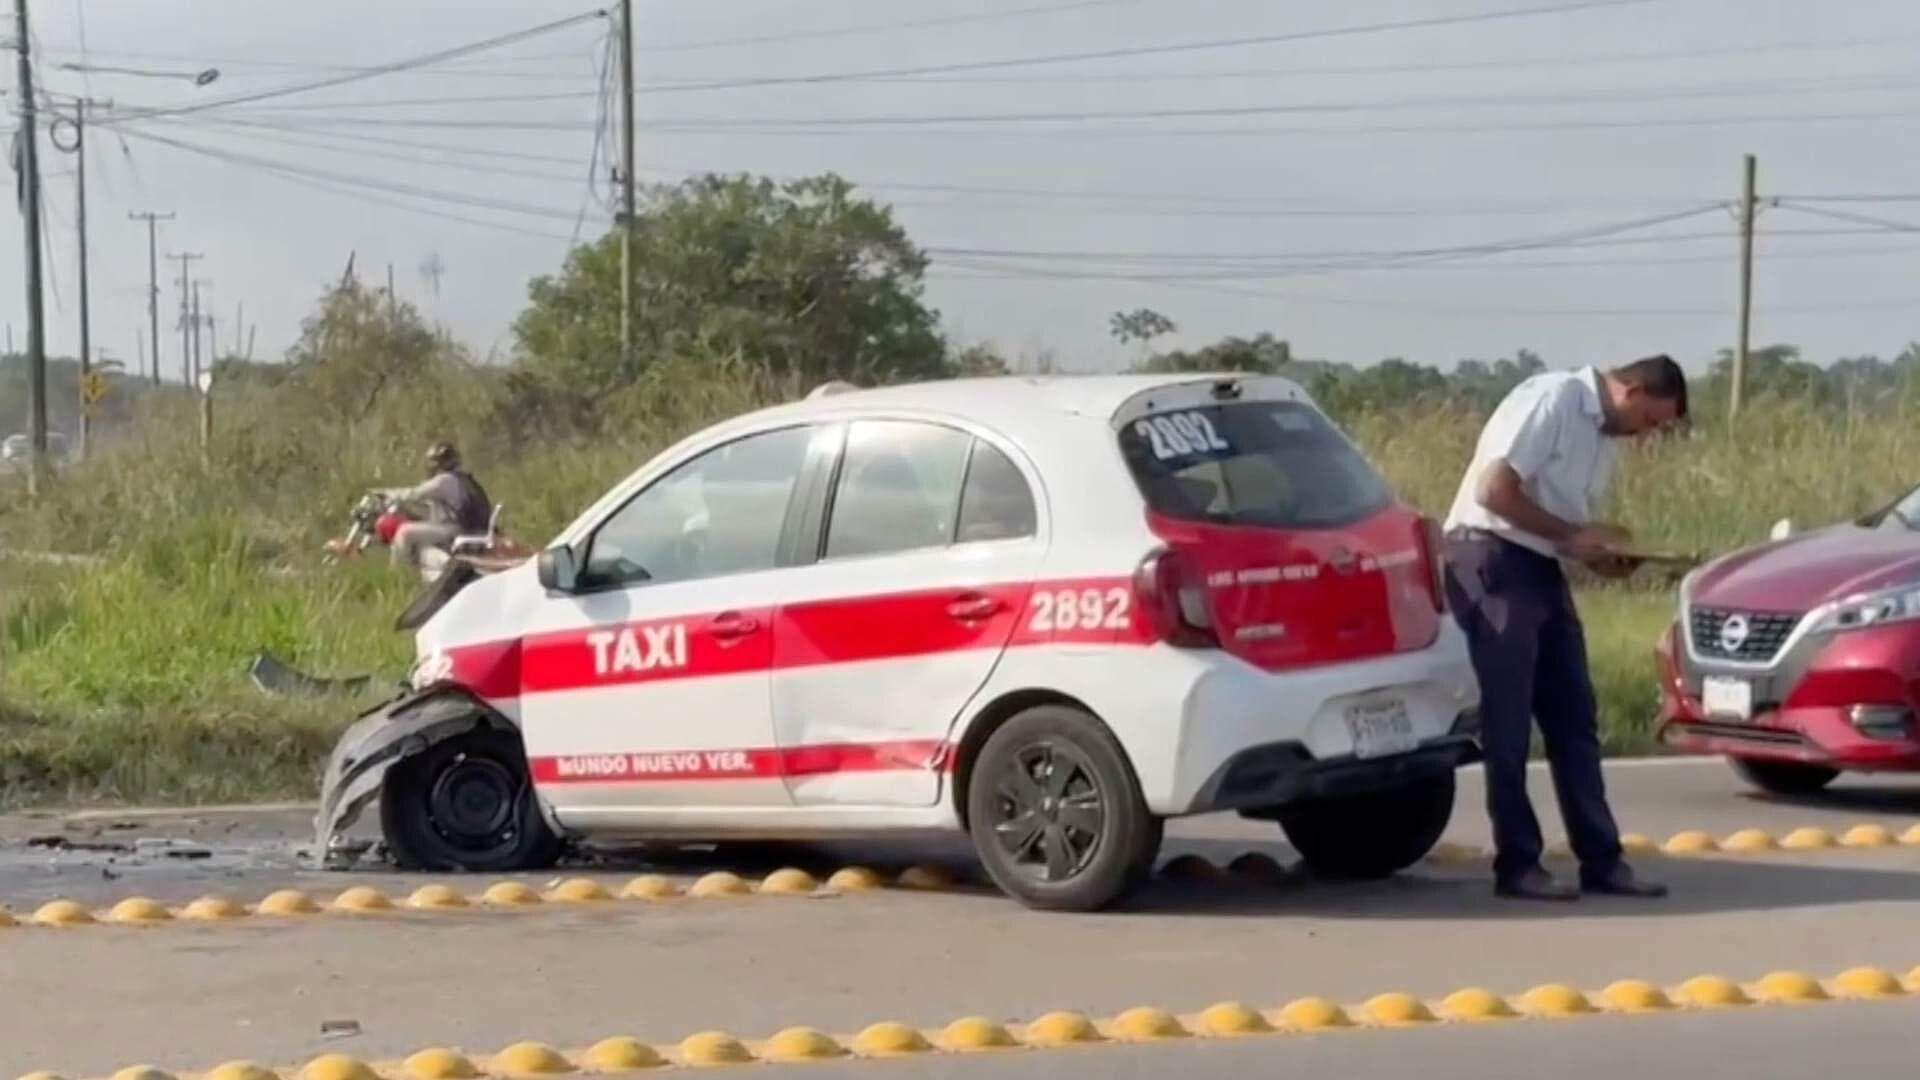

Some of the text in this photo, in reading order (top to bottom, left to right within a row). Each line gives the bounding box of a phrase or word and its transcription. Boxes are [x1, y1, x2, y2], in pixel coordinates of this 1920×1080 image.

[1135, 411, 1228, 460] 2892
[1029, 587, 1131, 631] 2892
[586, 624, 688, 675] TAXI
[557, 752, 754, 775] MUNDO NUEVO VER.
